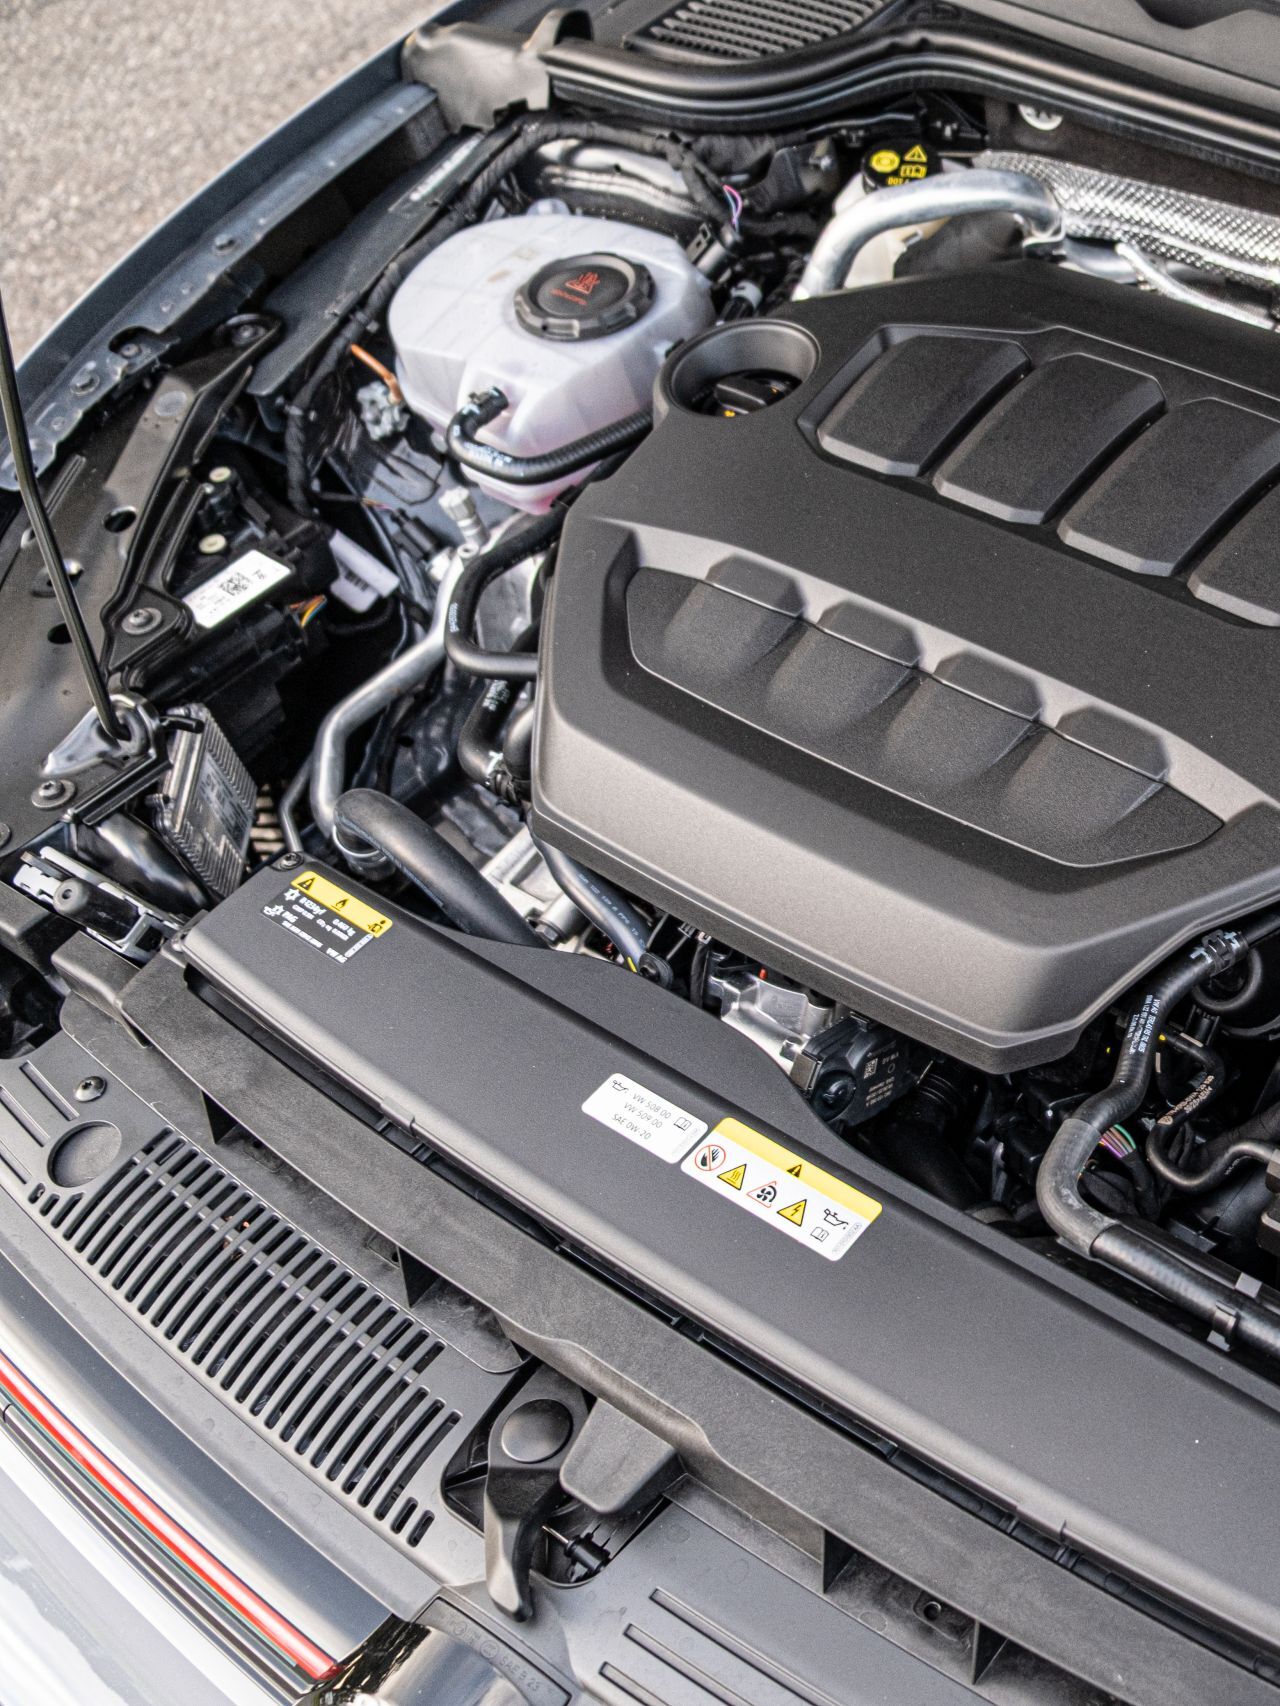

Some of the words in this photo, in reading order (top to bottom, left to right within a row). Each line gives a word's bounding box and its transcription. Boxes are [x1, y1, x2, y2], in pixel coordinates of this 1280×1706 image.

[611, 1113, 627, 1125] SAE
[624, 1102, 636, 1113] VW
[636, 1110, 652, 1121] 509
[651, 1119, 663, 1129] 00
[632, 1093, 646, 1104] VW
[645, 1100, 660, 1113] 508
[660, 1109, 672, 1119] 00
